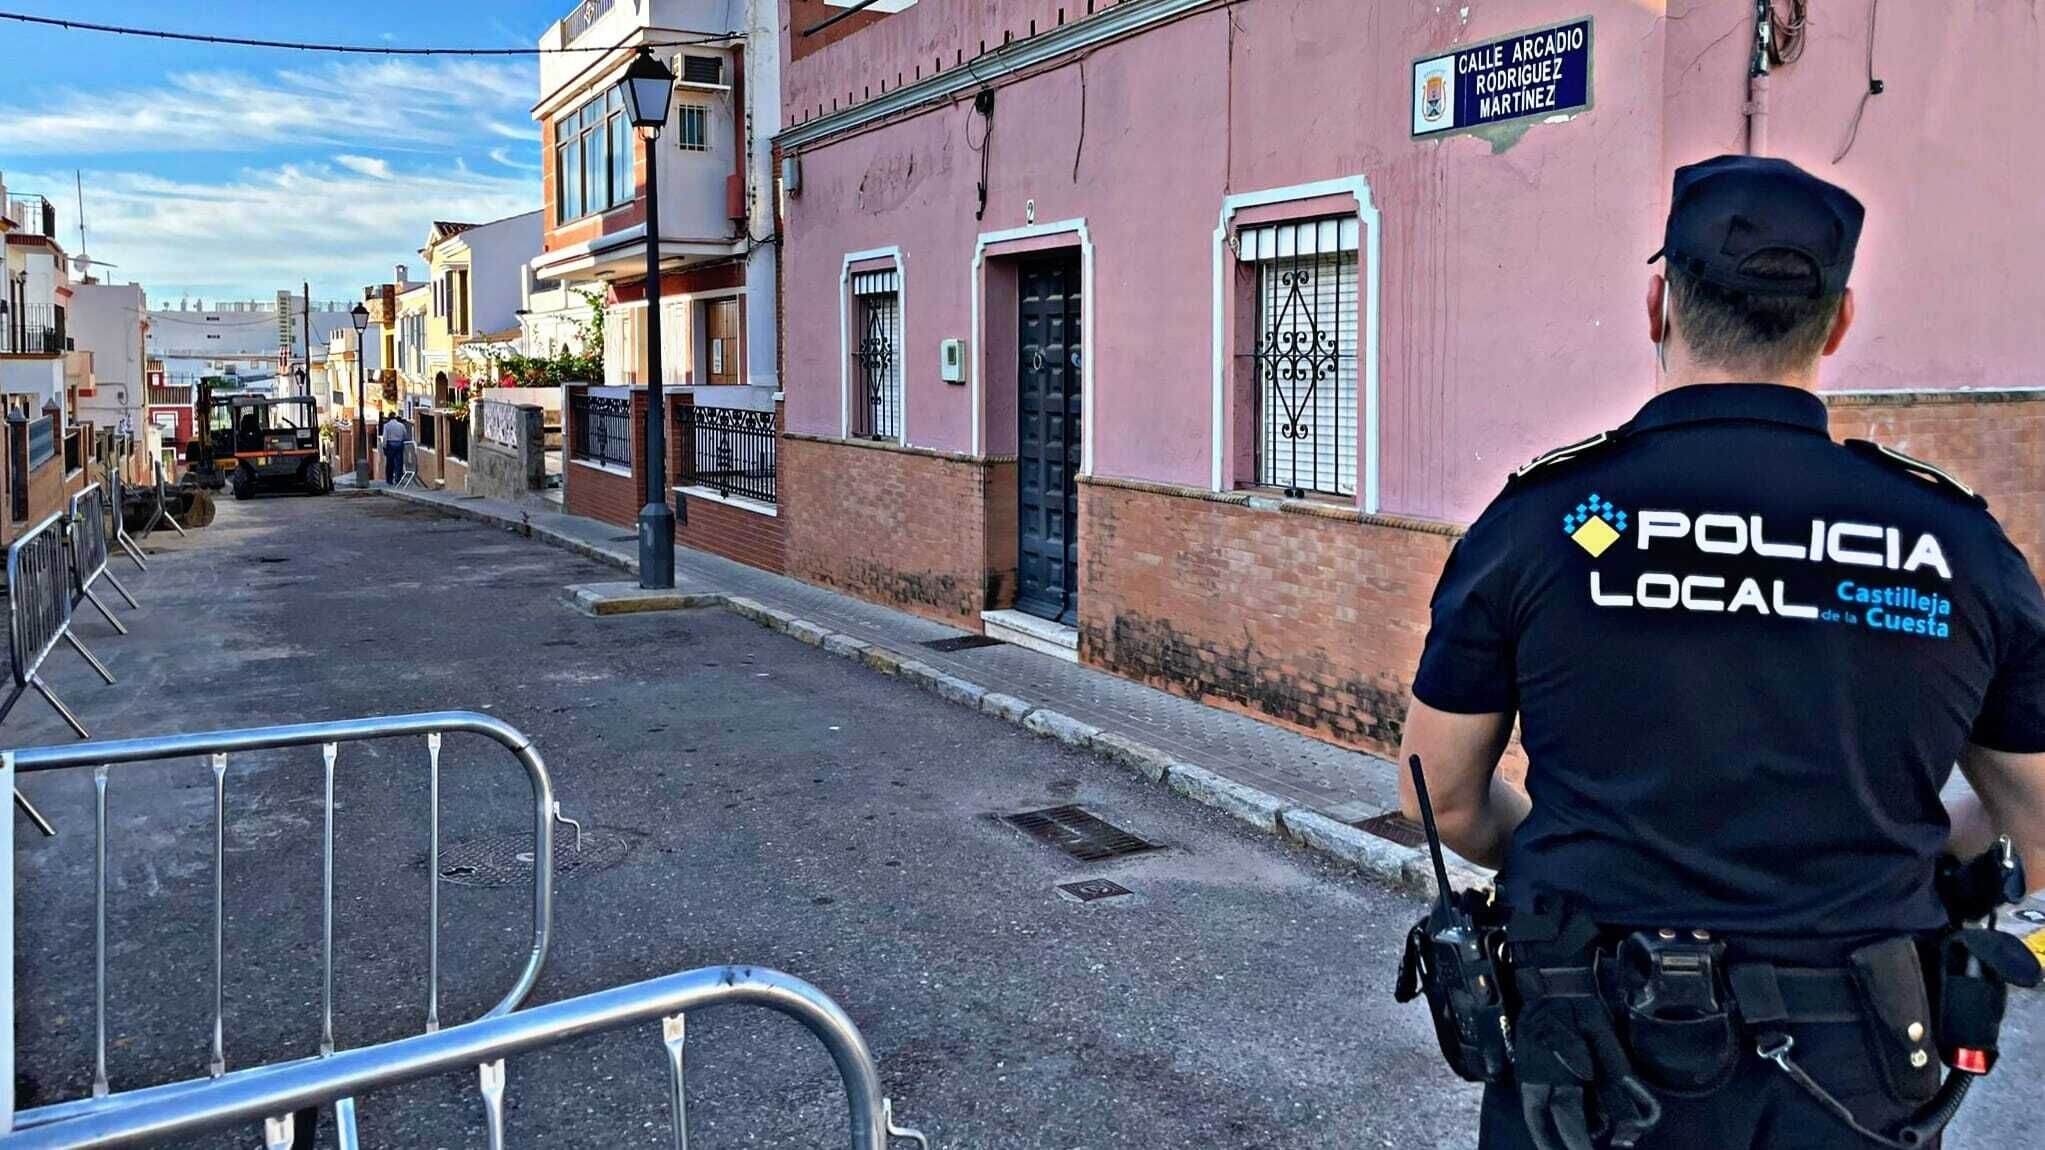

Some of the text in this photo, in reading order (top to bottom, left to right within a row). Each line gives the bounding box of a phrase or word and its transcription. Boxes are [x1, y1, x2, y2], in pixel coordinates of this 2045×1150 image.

[1459, 27, 1583, 75] CALLE ARCADIO
[1476, 57, 1563, 95] RODRIGUEZ
[1480, 84, 1556, 119] MARTÍNEZ
[1637, 510, 1952, 579] POLICIA
[1590, 571, 1819, 620] LOCAL
[1836, 580, 1951, 617] Castilleja
[1820, 607, 1949, 638] de la Cuesta
